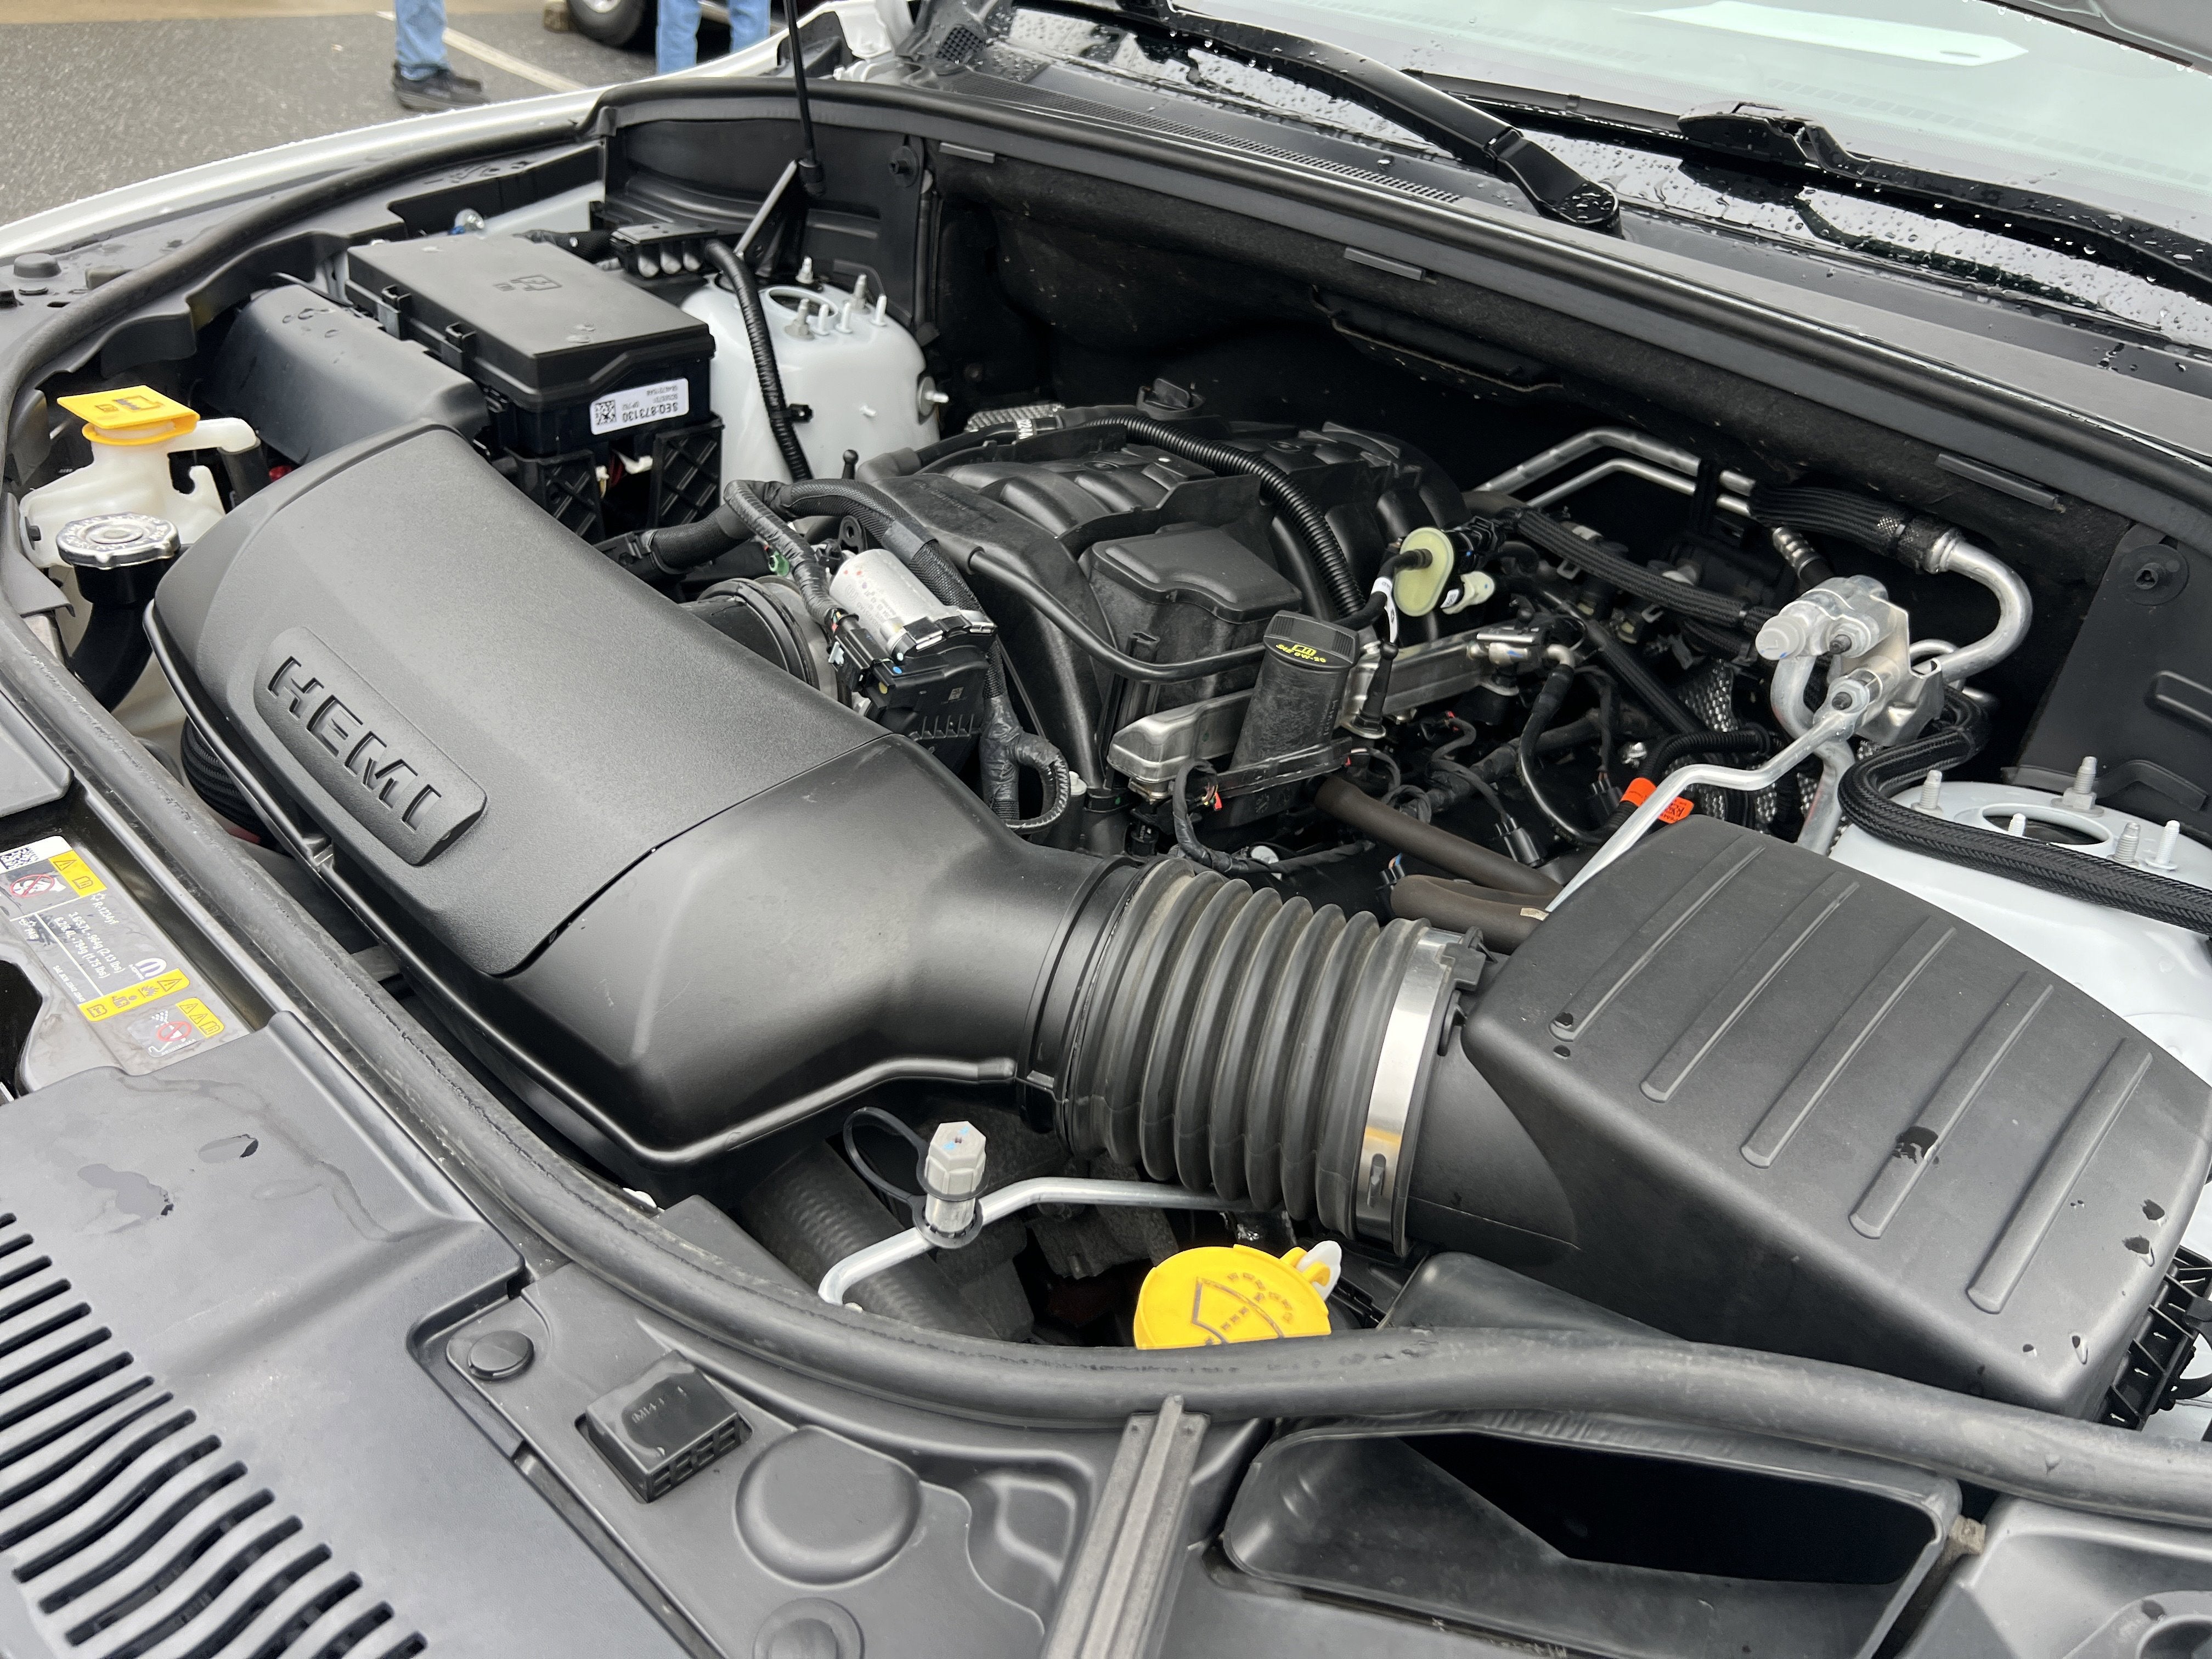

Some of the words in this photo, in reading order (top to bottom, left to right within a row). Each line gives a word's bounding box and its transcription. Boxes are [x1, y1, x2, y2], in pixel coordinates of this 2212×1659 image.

[267, 656, 442, 833] HEMI
[92, 901, 120, 924] R-1234yf
[24, 928, 40, 939] PAG
[72, 939, 88, 955] 794g
[94, 966, 110, 978] lbs)
[87, 934, 104, 950] 964g
[110, 960, 126, 973] lbs)
